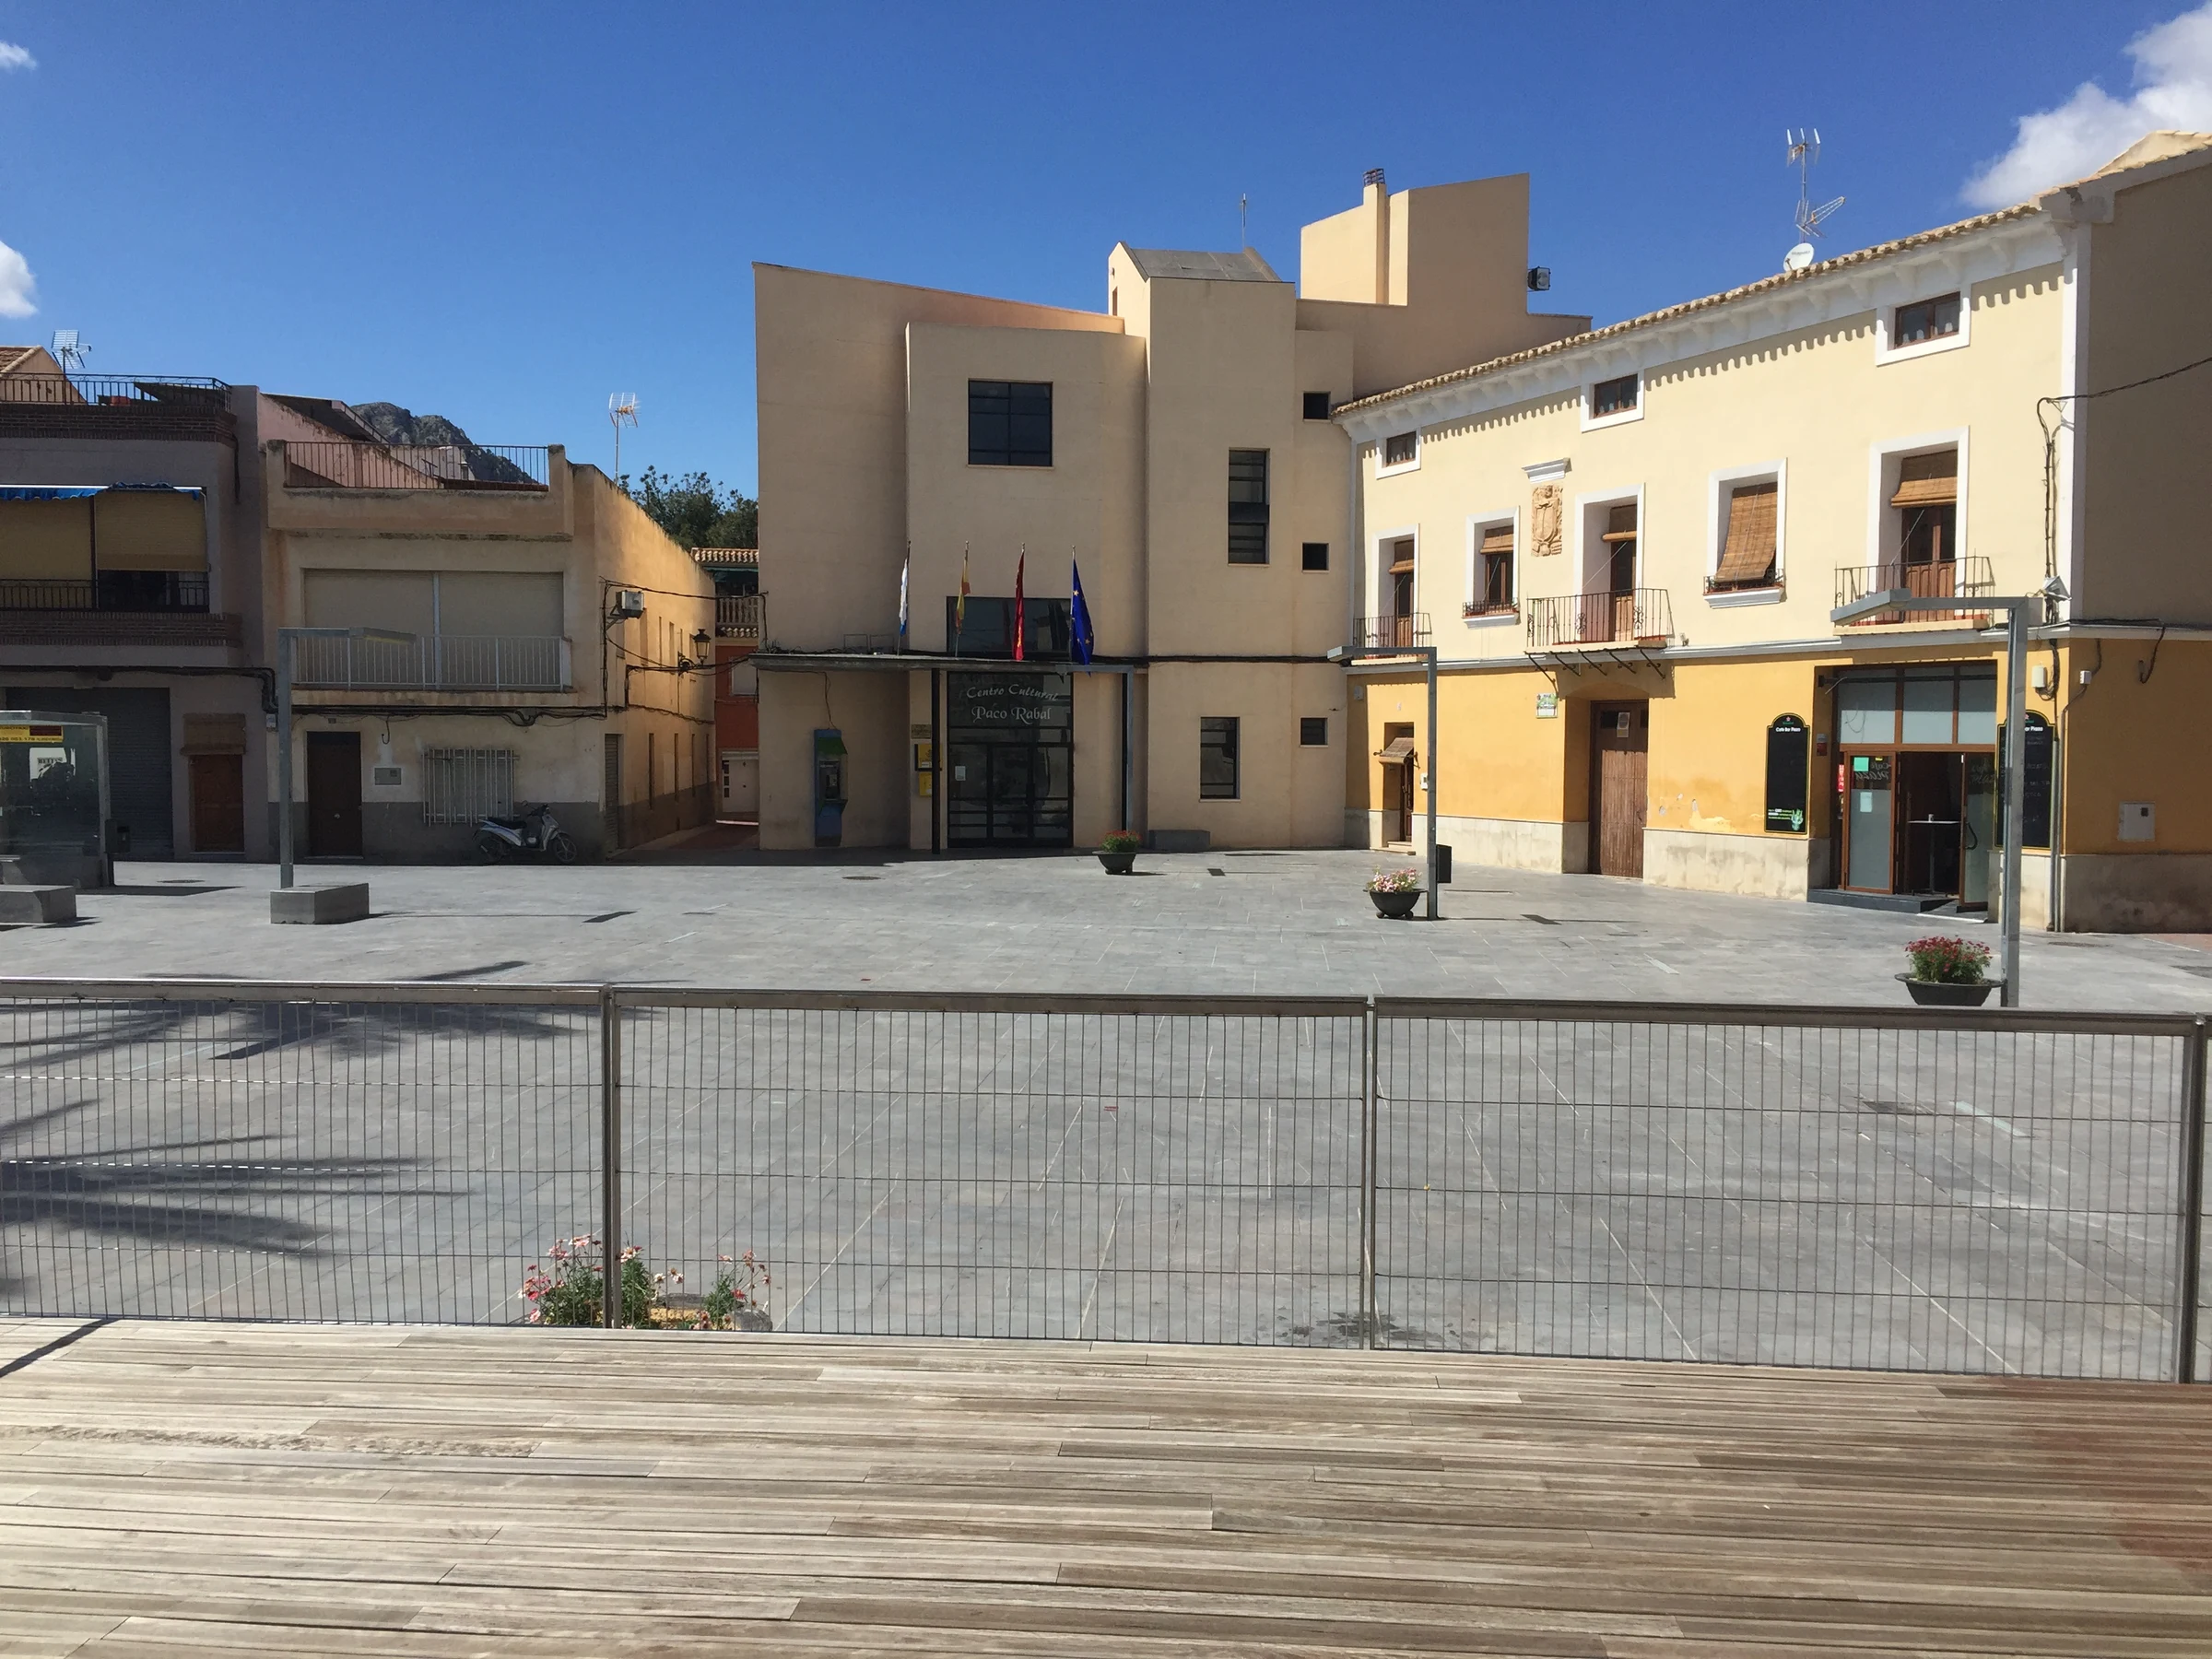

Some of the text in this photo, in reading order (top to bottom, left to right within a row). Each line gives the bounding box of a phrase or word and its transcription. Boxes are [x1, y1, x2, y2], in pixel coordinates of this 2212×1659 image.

[966, 683, 1059, 700] Centro Cultural
[971, 705, 1052, 725] Paco Rabal
